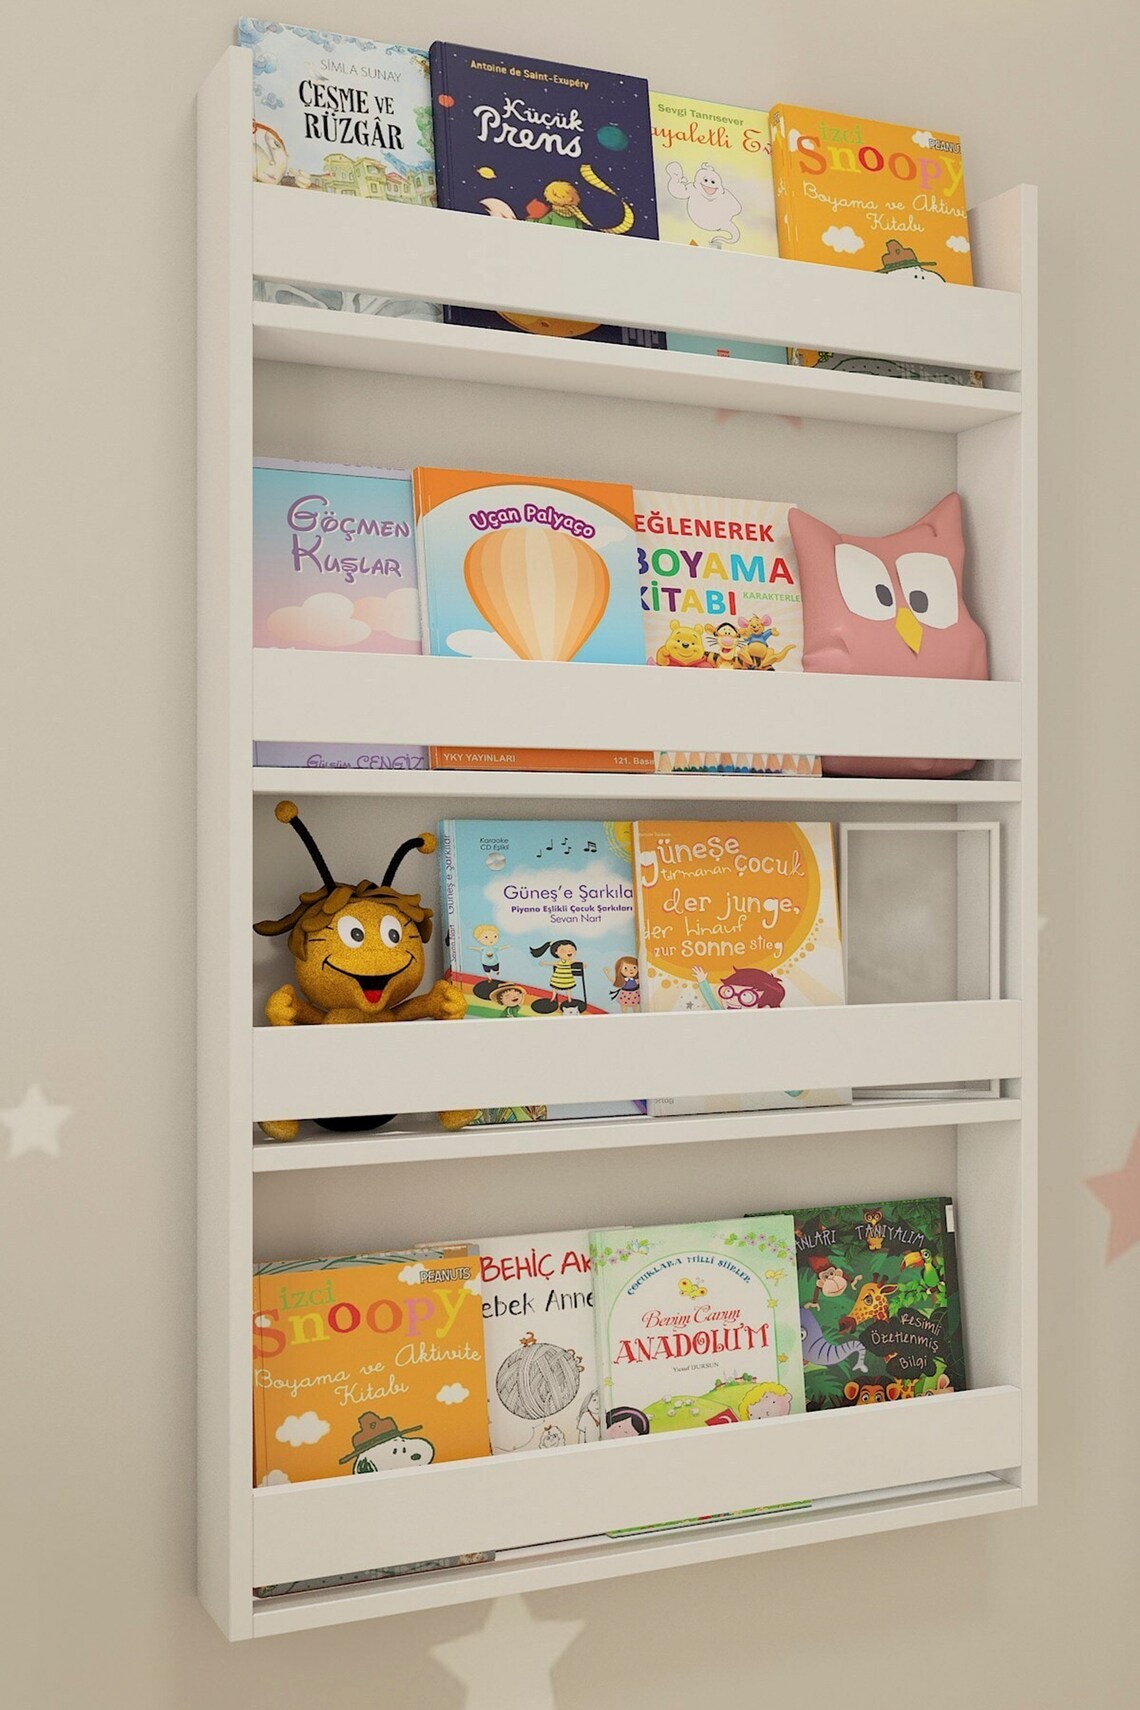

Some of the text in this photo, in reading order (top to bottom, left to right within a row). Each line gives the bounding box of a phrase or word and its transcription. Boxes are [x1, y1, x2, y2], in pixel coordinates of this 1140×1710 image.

[360, 66, 402, 82] SUNAY
[470, 60, 590, 91] Antoine de Saint-Exupéry
[299, 79, 395, 115] ÇEŞME VE
[502, 97, 585, 132] Küçük
[658, 103, 688, 118] Sevgi
[304, 111, 405, 150] RÜZGÂR
[473, 105, 582, 158] Prens
[819, 122, 864, 145] izci
[796, 136, 964, 197] Snoopy
[803, 180, 880, 213] Boyama
[885, 202, 905, 211] ve
[866, 213, 925, 233] Kitabı
[469, 503, 597, 539] Uçan Palyaço
[634, 510, 775, 543] EĞLENEREK
[443, 753, 516, 763] YKY YAYINLARI
[613, 756, 631, 766] 121.
[480, 837, 509, 845] Karaoke
[480, 844, 492, 852] CD
[734, 850, 805, 877] çocuk
[503, 883, 633, 903] Güneş'e Şarkıla
[511, 905, 541, 915] Piyano
[543, 904, 568, 915] Eşlikli
[570, 905, 595, 914] Çocuk
[550, 914, 602, 924] Sevan Nart
[663, 888, 800, 929] der junge,
[644, 915, 747, 940] der hinauf
[654, 935, 784, 959] zur sonne stieg
[855, 1224, 925, 1247] TANIYALIM
[419, 1267, 472, 1284] PEANUTS
[480, 1248, 555, 1283] BEHİÇ
[627, 1257, 683, 1296] ÇOCUKLARA
[280, 1280, 336, 1312] izci
[482, 1292, 536, 1319] ebek
[253, 1288, 472, 1361] Snoopy
[641, 1309, 692, 1330] Benim
[871, 1329, 939, 1354] Özetlenmiş
[254, 1342, 482, 1398] Boyama ve Aktivite
[691, 1361, 720, 1372] DURSUN
[899, 1355, 927, 1370] Bilgi
[334, 1374, 410, 1407] Kitabı
